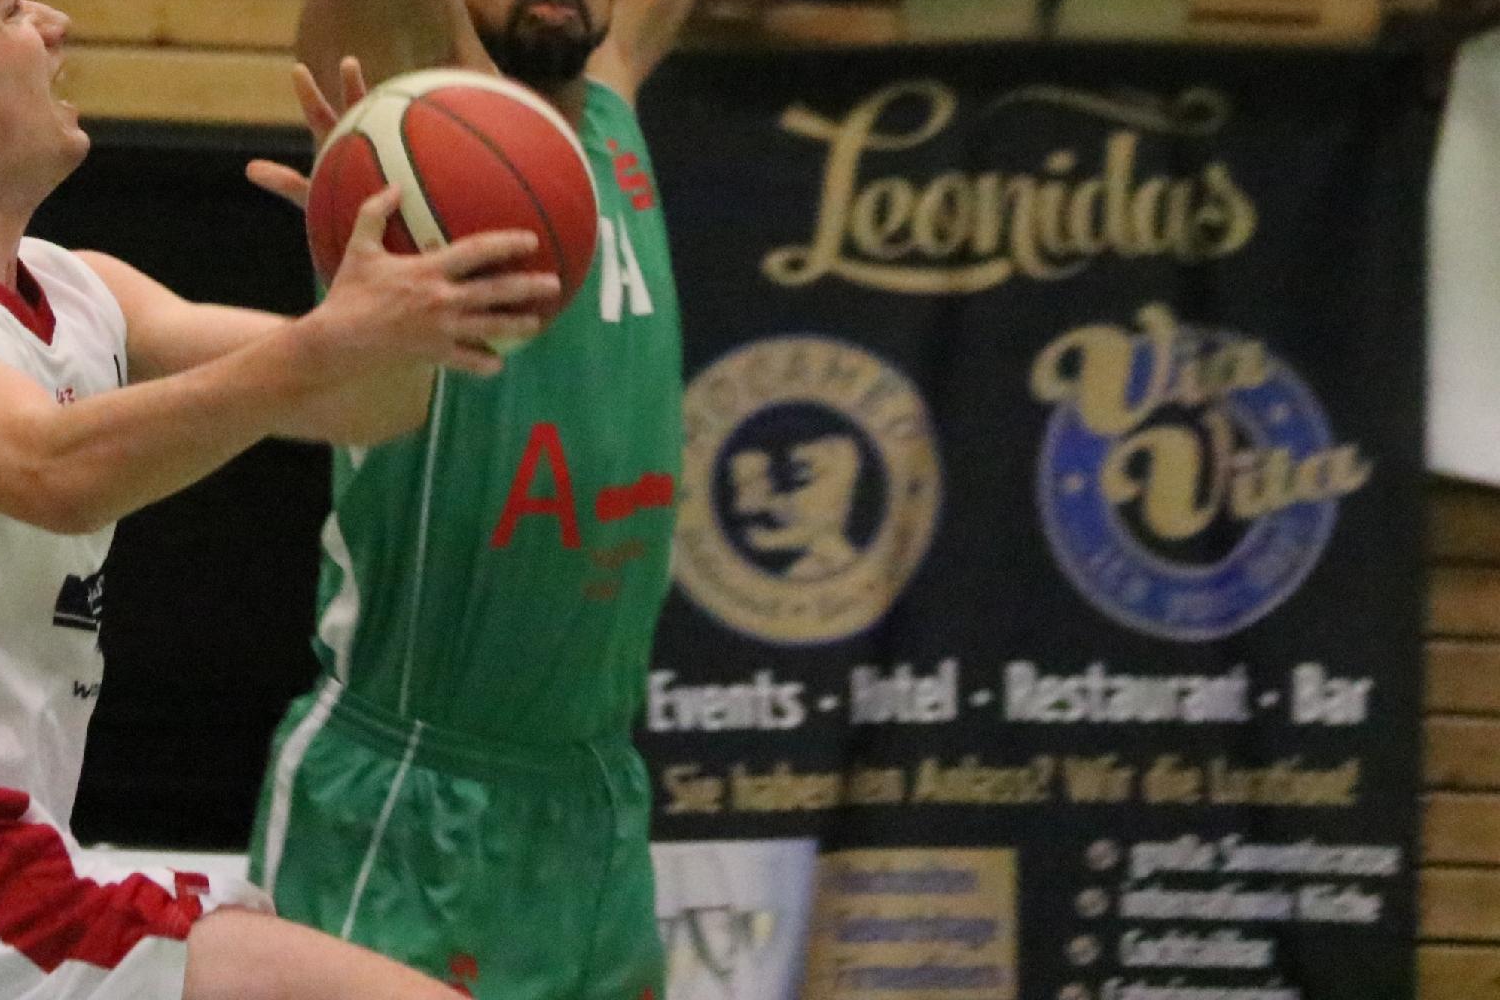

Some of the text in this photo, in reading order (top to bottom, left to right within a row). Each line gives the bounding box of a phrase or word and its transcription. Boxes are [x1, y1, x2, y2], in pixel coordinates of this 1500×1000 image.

[761, 80, 1258, 294] Leonidas
[647, 668, 804, 732] Events
[849, 656, 959, 725] Hotel
[1004, 659, 1251, 723] Restaurant
[1291, 661, 1373, 726] Bar
